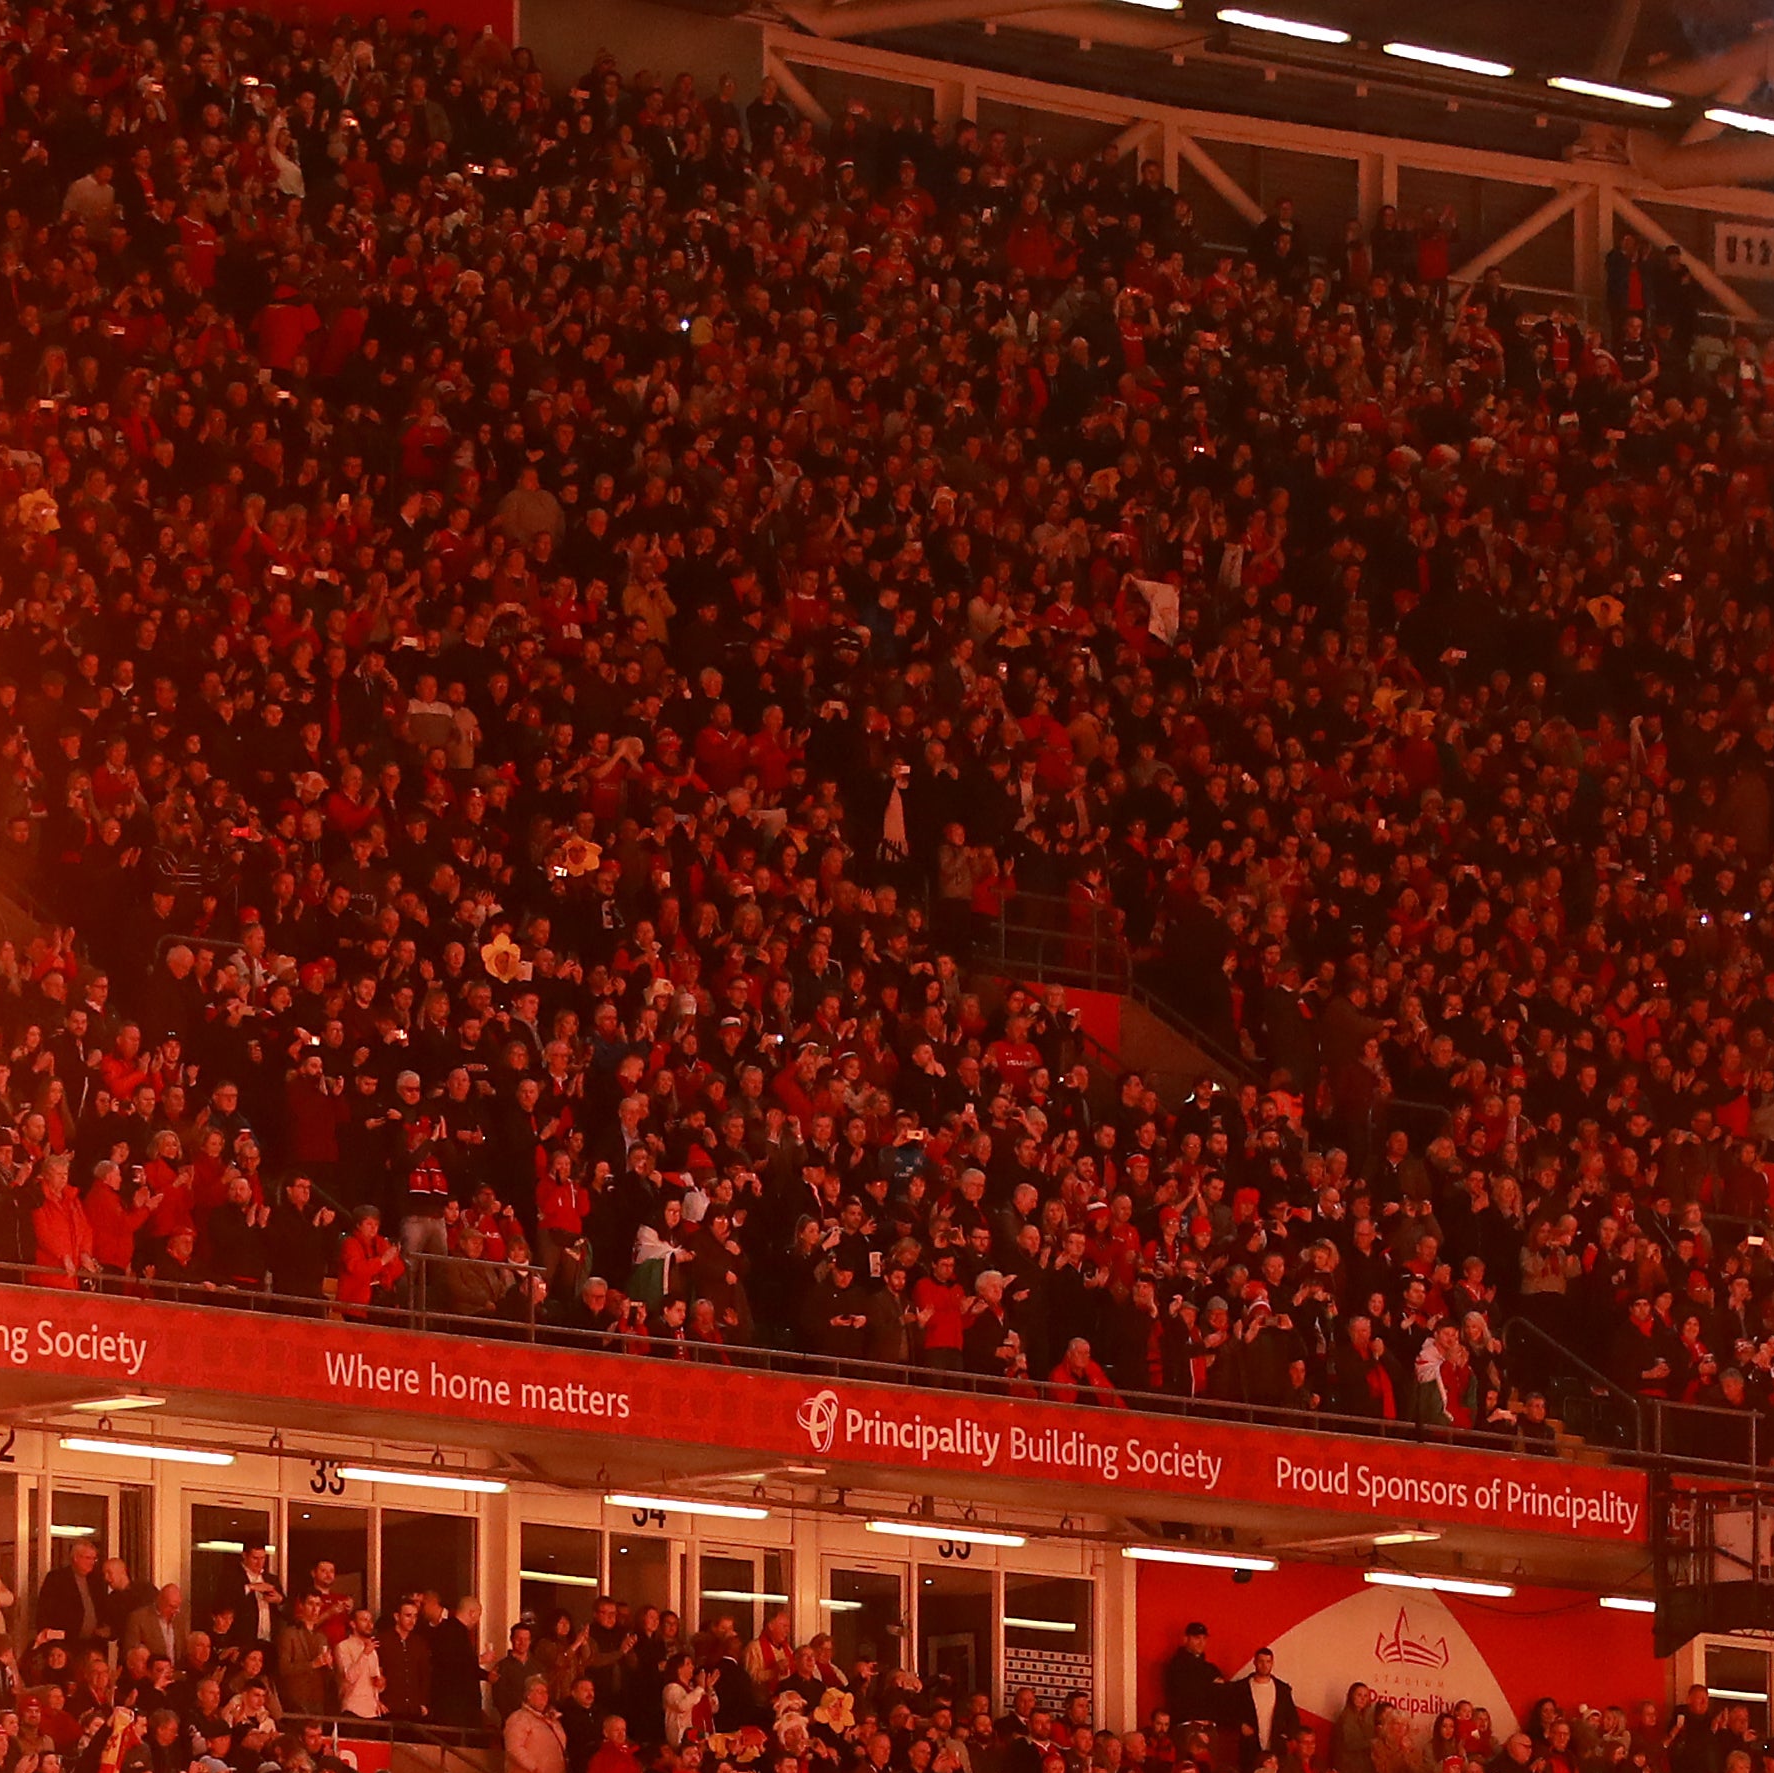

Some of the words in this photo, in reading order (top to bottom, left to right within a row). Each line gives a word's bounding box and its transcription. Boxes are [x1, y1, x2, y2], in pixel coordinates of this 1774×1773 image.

[37, 1319, 148, 1374] Society
[324, 1350, 420, 1393] Where
[429, 1361, 510, 1407] home
[520, 1381, 631, 1419] matters
[310, 1459, 345, 1496] 33
[845, 1407, 1000, 1466] Principality
[1010, 1427, 1119, 1481] Building
[1126, 1438, 1222, 1490] Society
[1276, 1456, 1350, 1496] Proud
[1356, 1464, 1468, 1509] Sponsors
[1474, 1477, 1502, 1510] of
[1506, 1481, 1640, 1536] Principality
